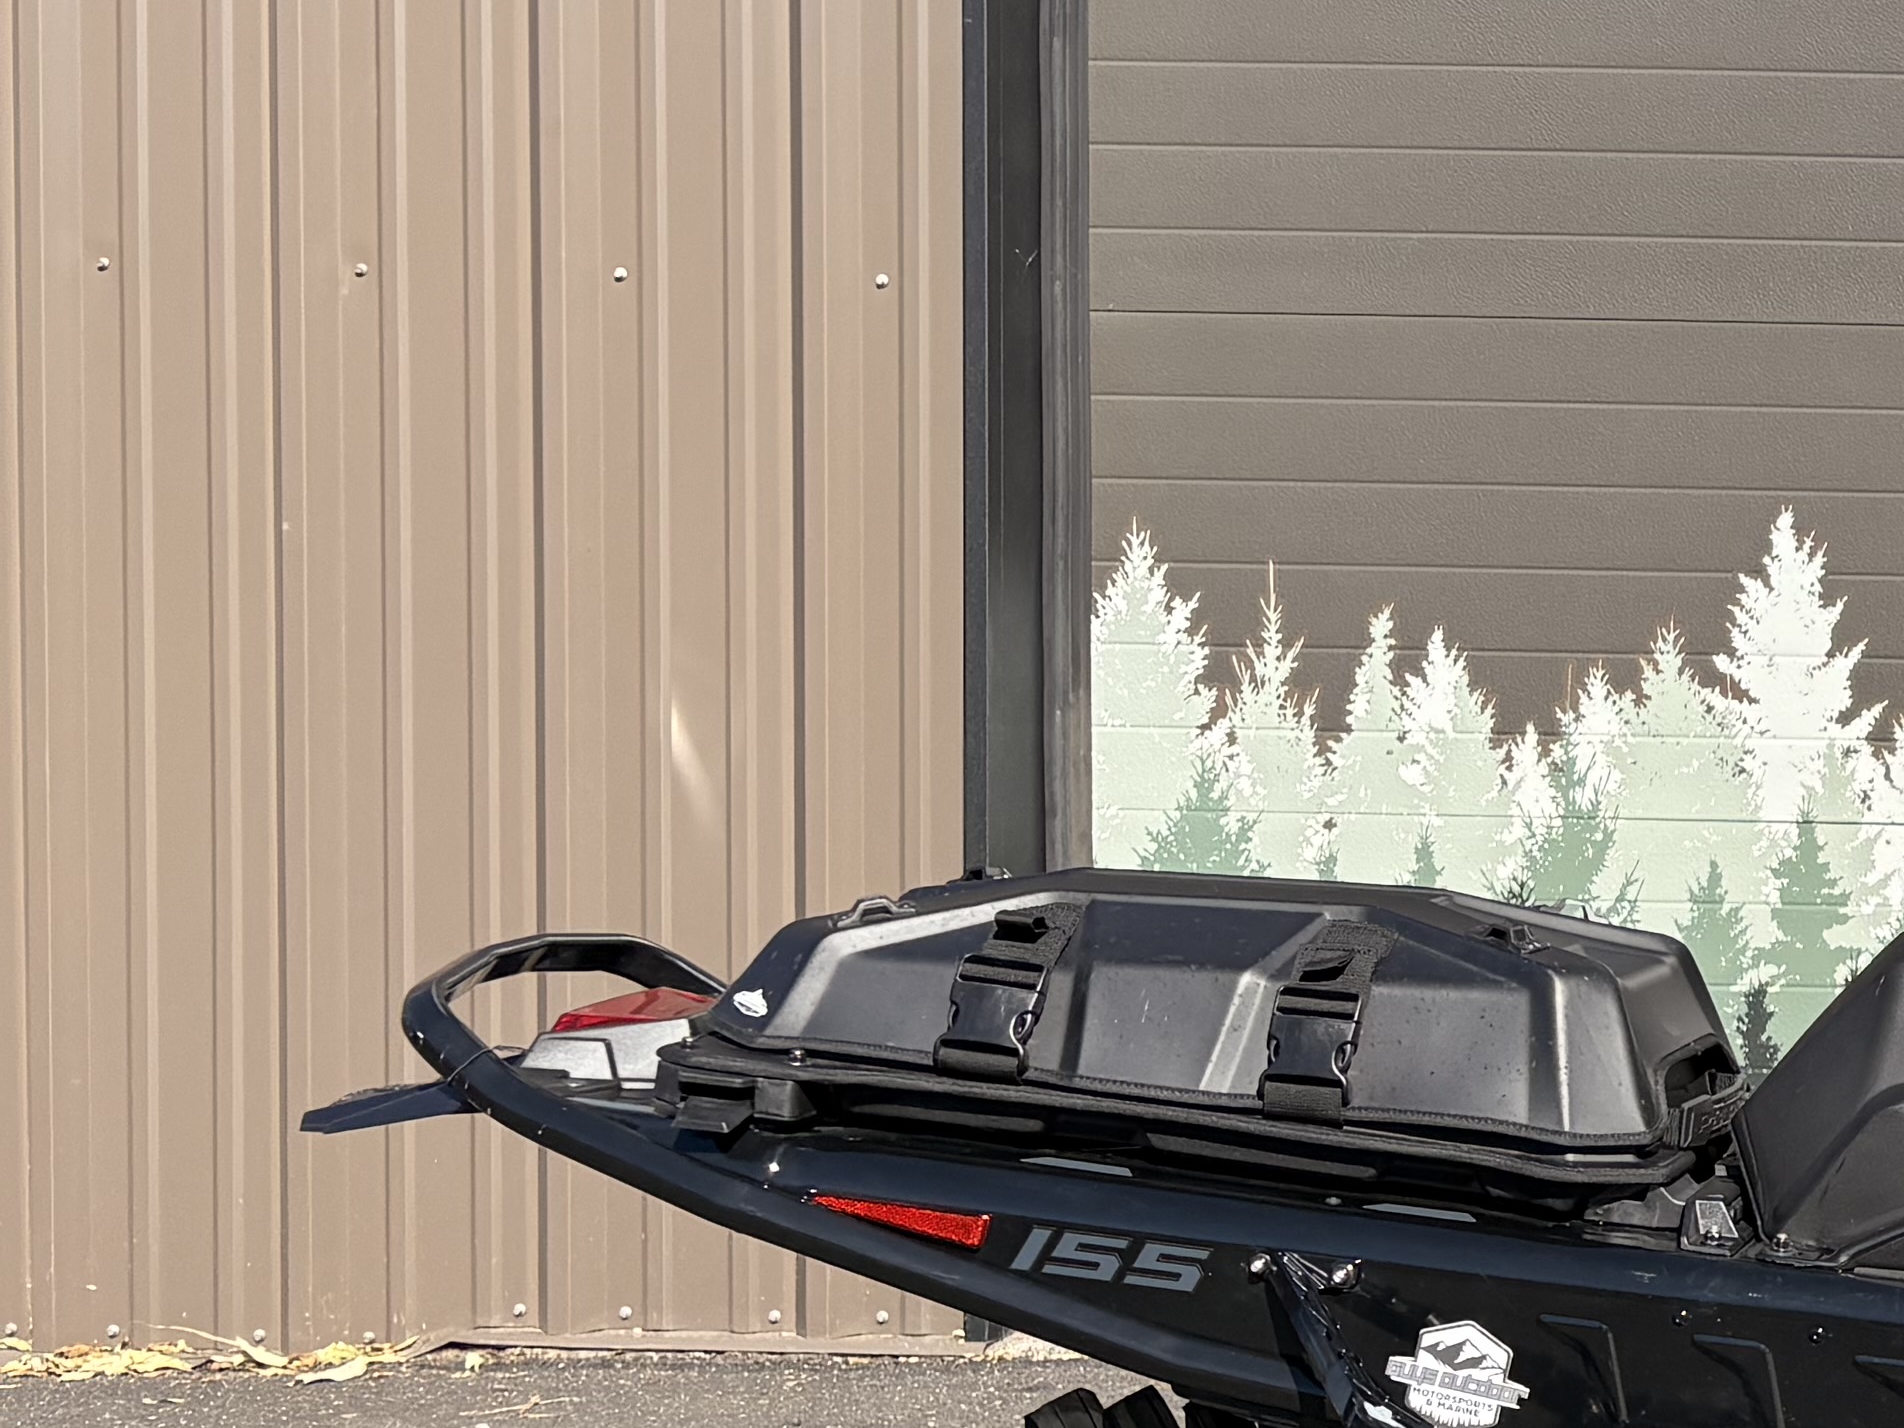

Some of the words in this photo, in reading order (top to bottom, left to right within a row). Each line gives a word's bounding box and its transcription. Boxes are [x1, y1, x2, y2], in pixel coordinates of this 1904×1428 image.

[1009, 1226, 1213, 1292] 155
[1413, 1386, 1494, 1412] MOTORSPORTS
[1437, 1400, 1480, 1418] MARINE
